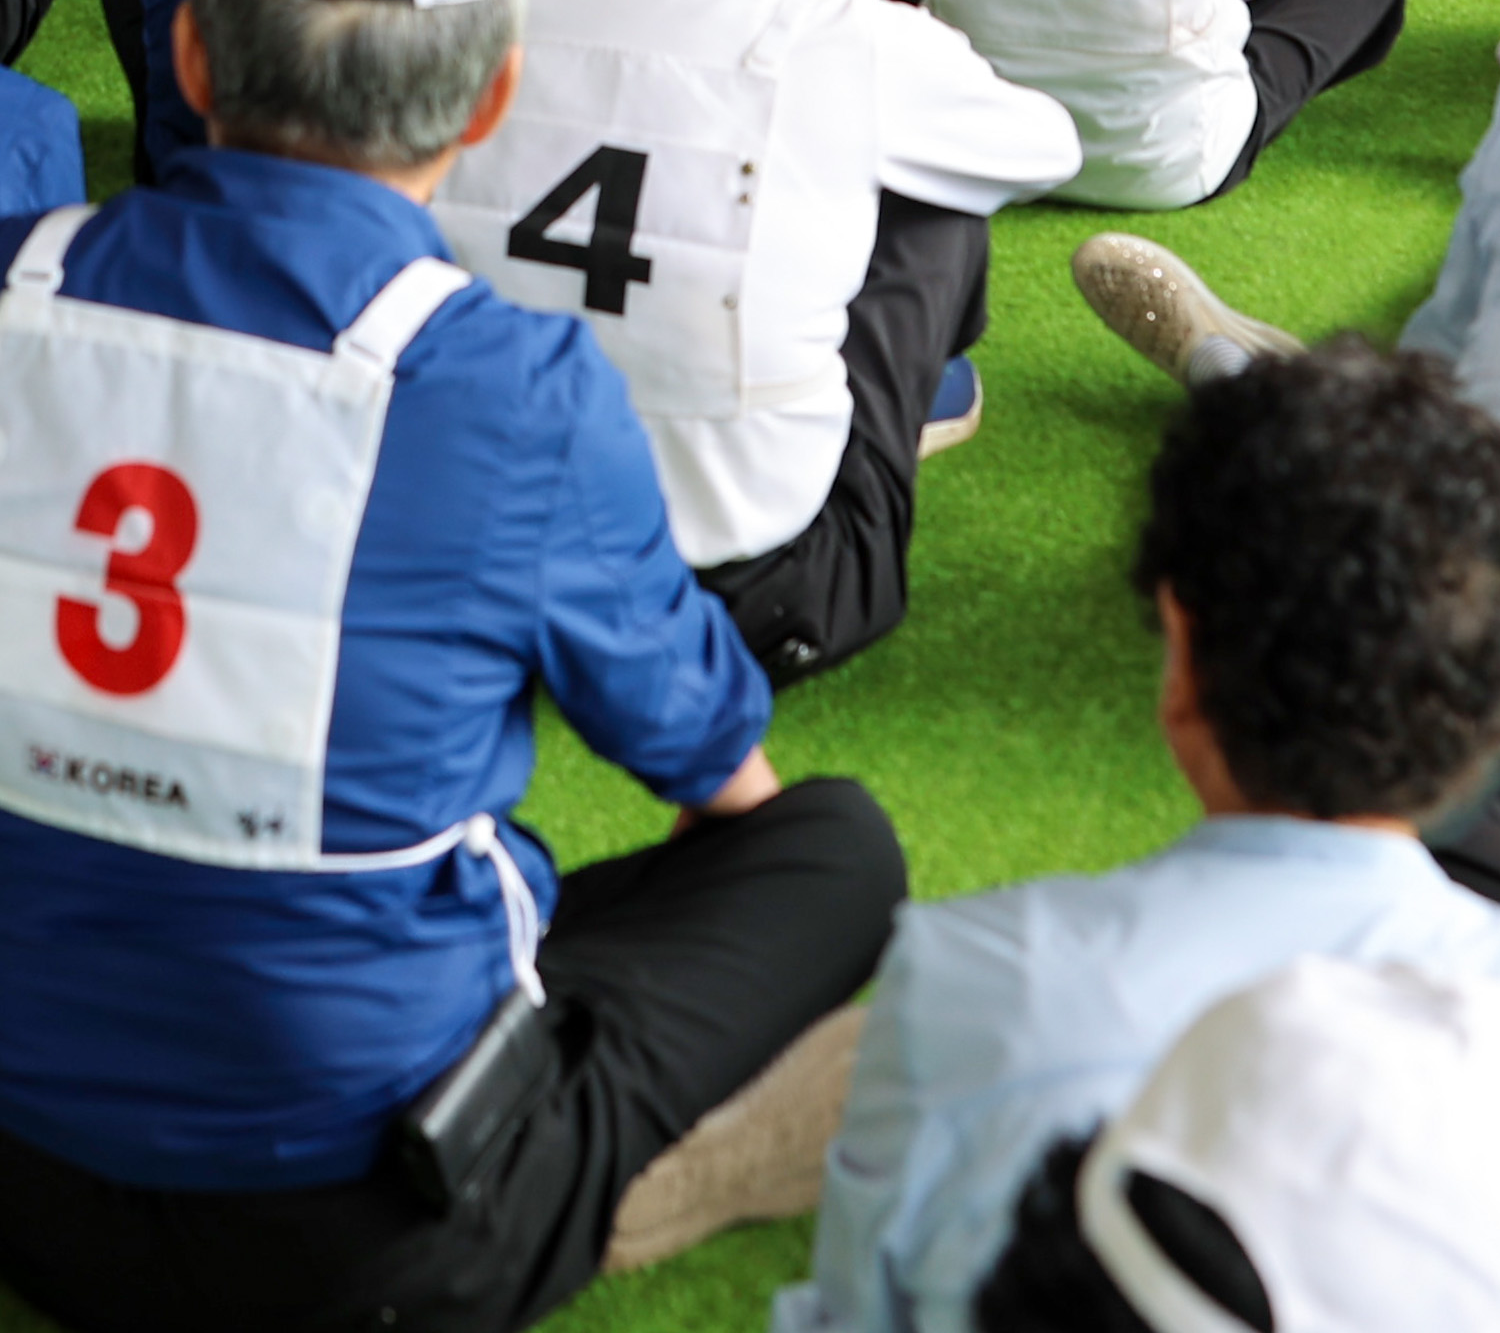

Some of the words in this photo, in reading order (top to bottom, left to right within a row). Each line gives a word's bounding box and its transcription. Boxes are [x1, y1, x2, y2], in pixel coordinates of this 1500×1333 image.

[506, 144, 653, 317] 4
[53, 461, 200, 699] 3
[63, 755, 190, 813] KOREA
